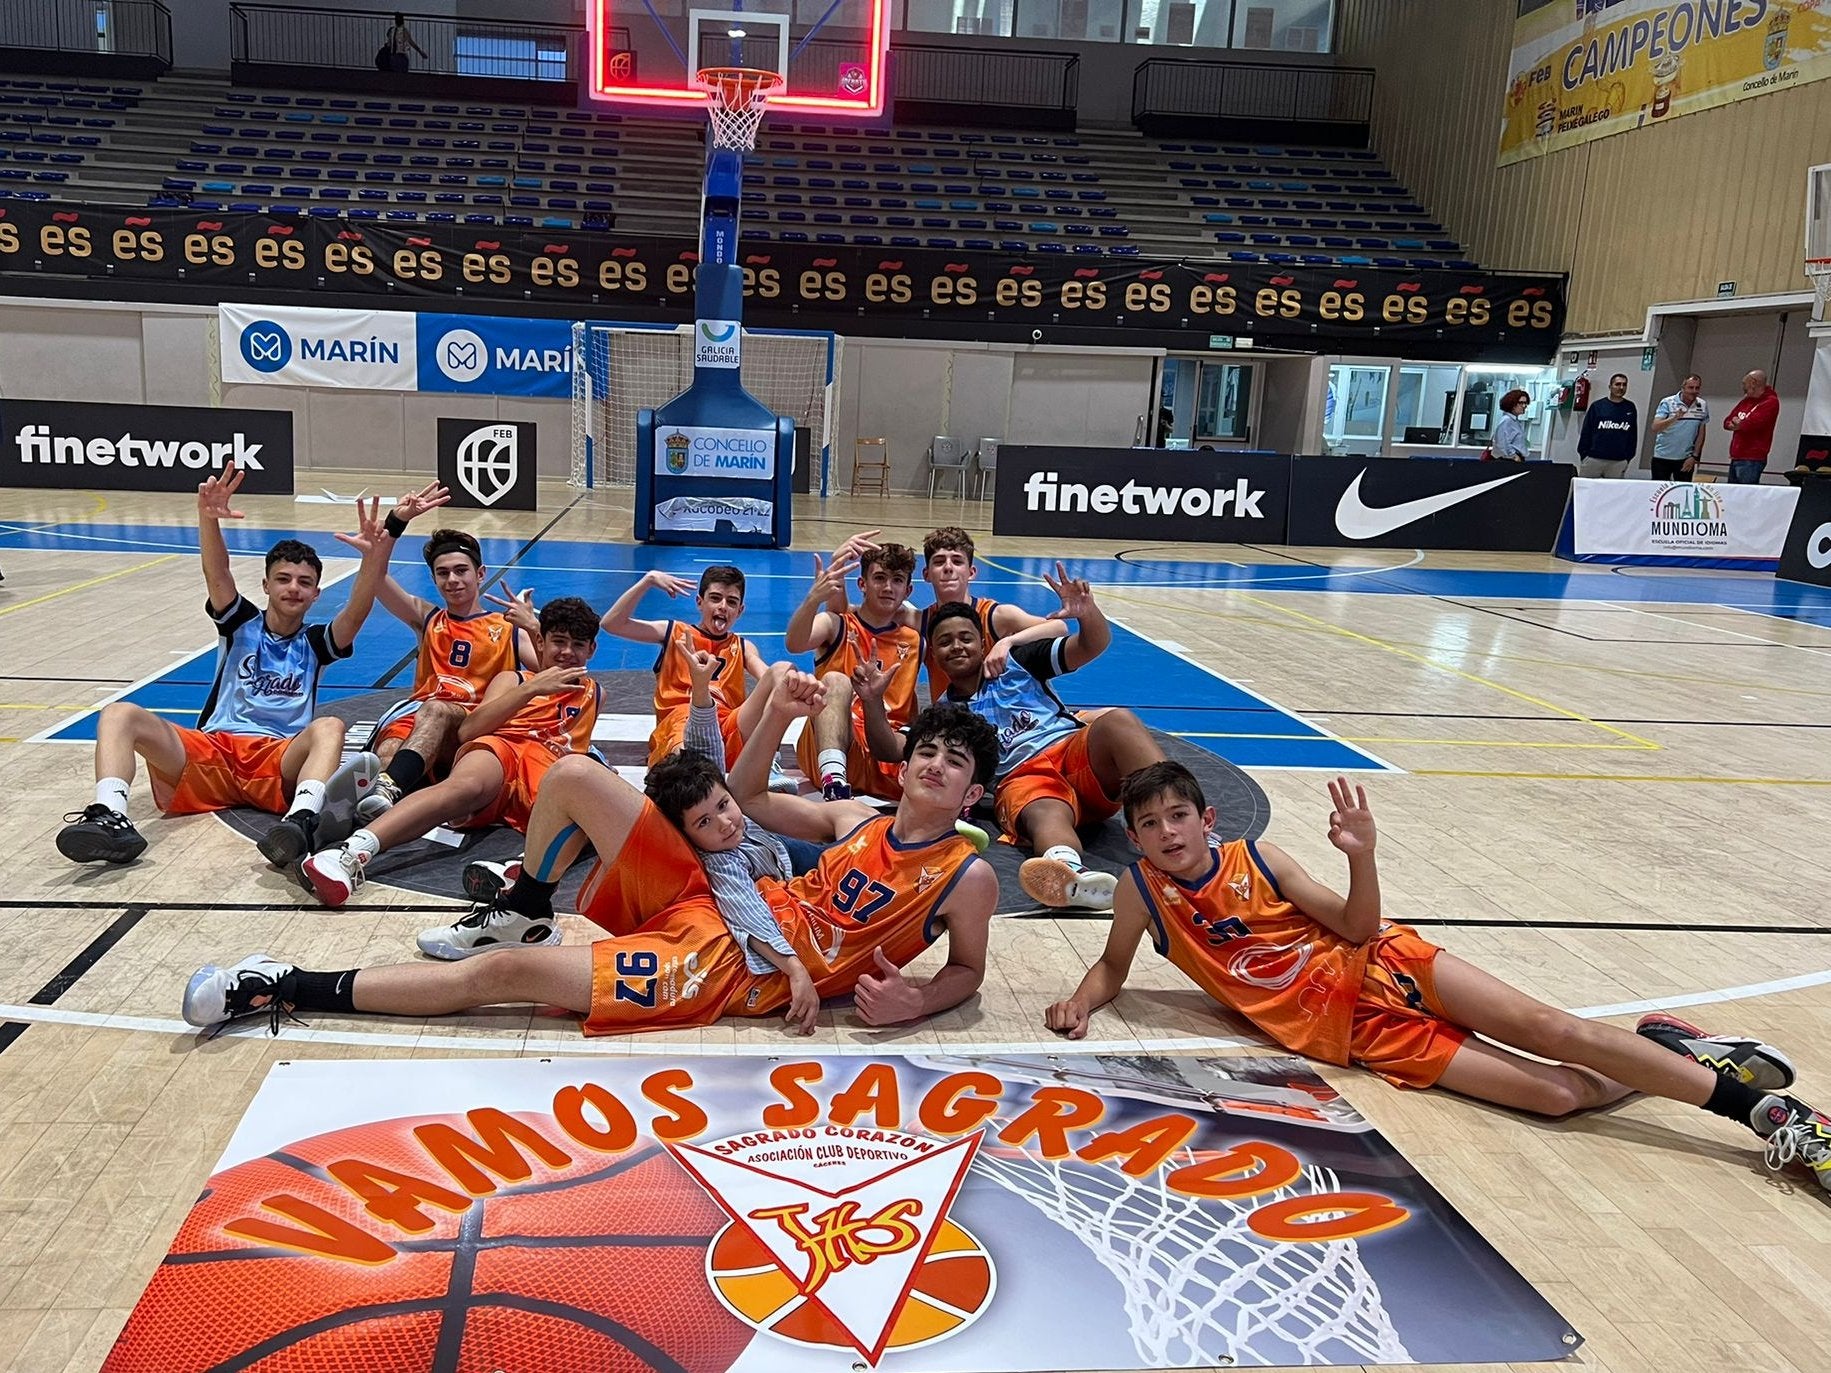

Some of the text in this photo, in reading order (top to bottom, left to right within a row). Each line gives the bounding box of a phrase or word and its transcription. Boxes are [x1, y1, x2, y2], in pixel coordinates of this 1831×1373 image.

[1562, 0, 1768, 91] CAMPEONES
[716, 231, 725, 264] MONDO
[300, 335, 399, 365] MARÍN
[496, 345, 572, 373] MARÍ
[696, 353, 739, 364] SAUDABLE
[701, 345, 735, 355] GALICIA
[15, 425, 264, 471] finetwork
[492, 428, 513, 440] FEB
[693, 437, 767, 453] CONCELLO
[693, 453, 766, 470] DE MARÍN
[1024, 471, 1266, 519] finetwork
[1651, 521, 1727, 537] MUNDIOMA
[449, 640, 474, 669] 8
[832, 867, 896, 925] 97
[615, 951, 658, 1008] 97
[713, 1126, 936, 1156] SAGRADO CORAZÓN
[746, 1144, 909, 1163] ASOCIACIÓN CLUB DEPORTIVO
[223, 1061, 1412, 1266] VAMOS SAGRADO
